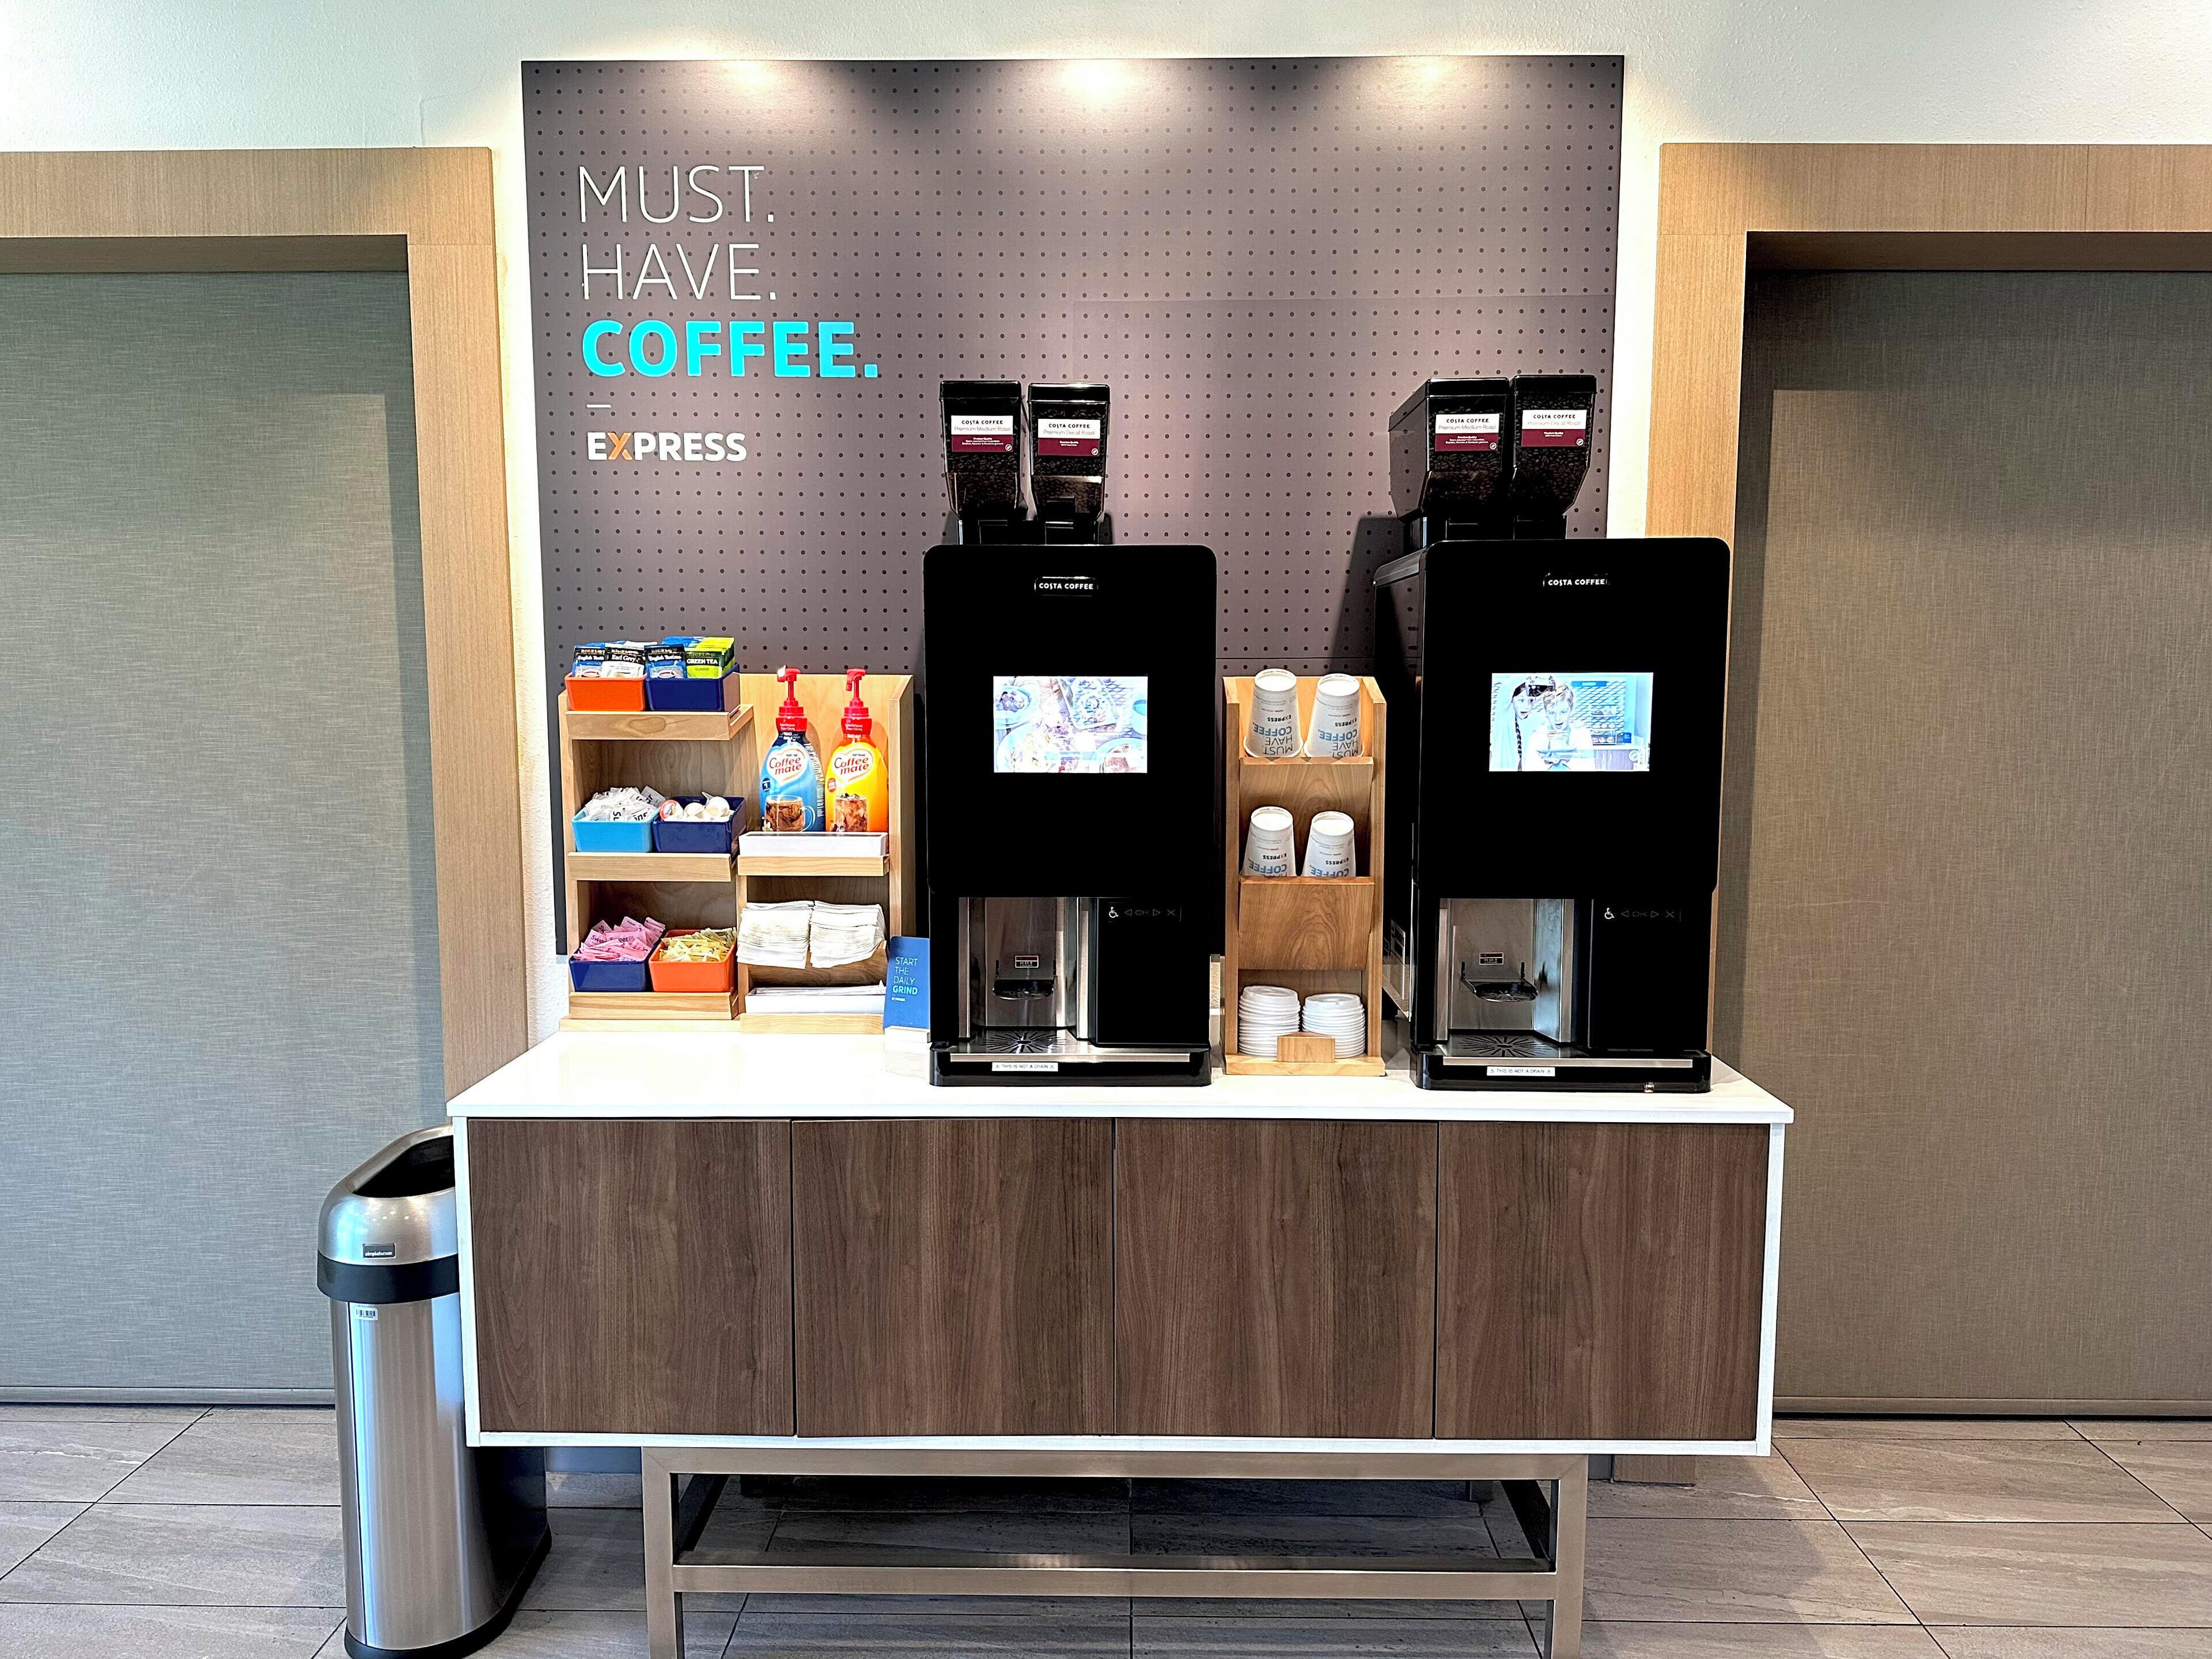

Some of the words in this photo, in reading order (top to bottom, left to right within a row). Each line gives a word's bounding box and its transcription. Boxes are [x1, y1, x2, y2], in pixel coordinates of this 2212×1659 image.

[578, 165, 774, 224] MUST.
[581, 243, 777, 300] HAVE.
[582, 320, 878, 377] COFFEE.
[586, 432, 747, 461] EXPRESS
[1253, 722, 1292, 737] COFFEE.
[1318, 729, 1357, 741] COFFEE.
[770, 757, 801, 768] Coffee
[835, 757, 869, 768] Coffee
[775, 763, 802, 776] mate
[840, 763, 869, 776] mate
[1325, 857, 1349, 865] EXPRESS
[895, 957, 919, 966] START
[895, 966, 909, 975] THE
[893, 976, 915, 985] DAILY
[892, 985, 918, 995] GRIND
